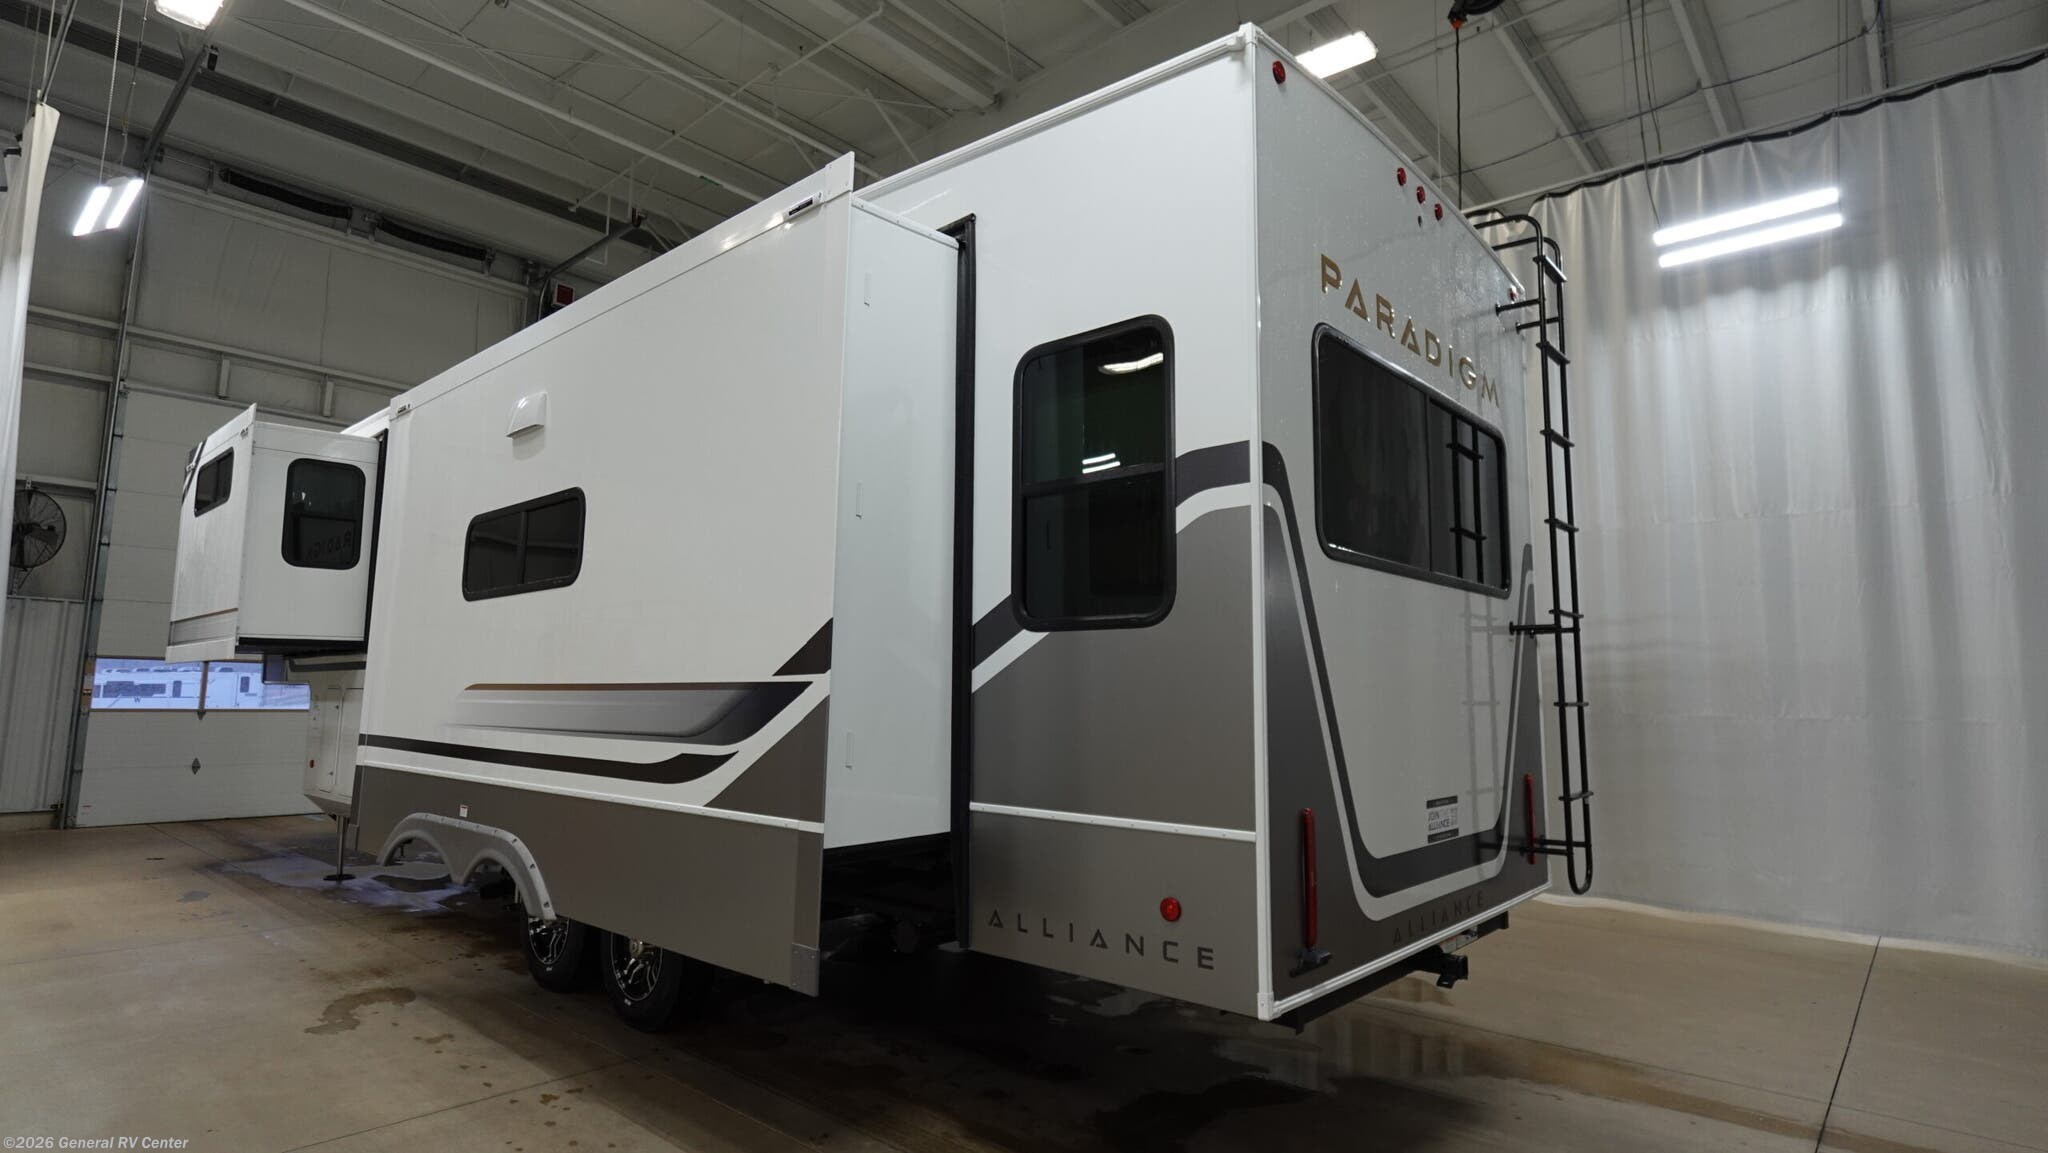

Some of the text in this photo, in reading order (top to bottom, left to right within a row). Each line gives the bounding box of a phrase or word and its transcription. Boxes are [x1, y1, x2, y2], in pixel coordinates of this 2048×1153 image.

[1320, 253, 1500, 408] PARADIGM
[988, 909, 1214, 970] ALLIANCE
[1393, 890, 1485, 945] ALLIANCE
